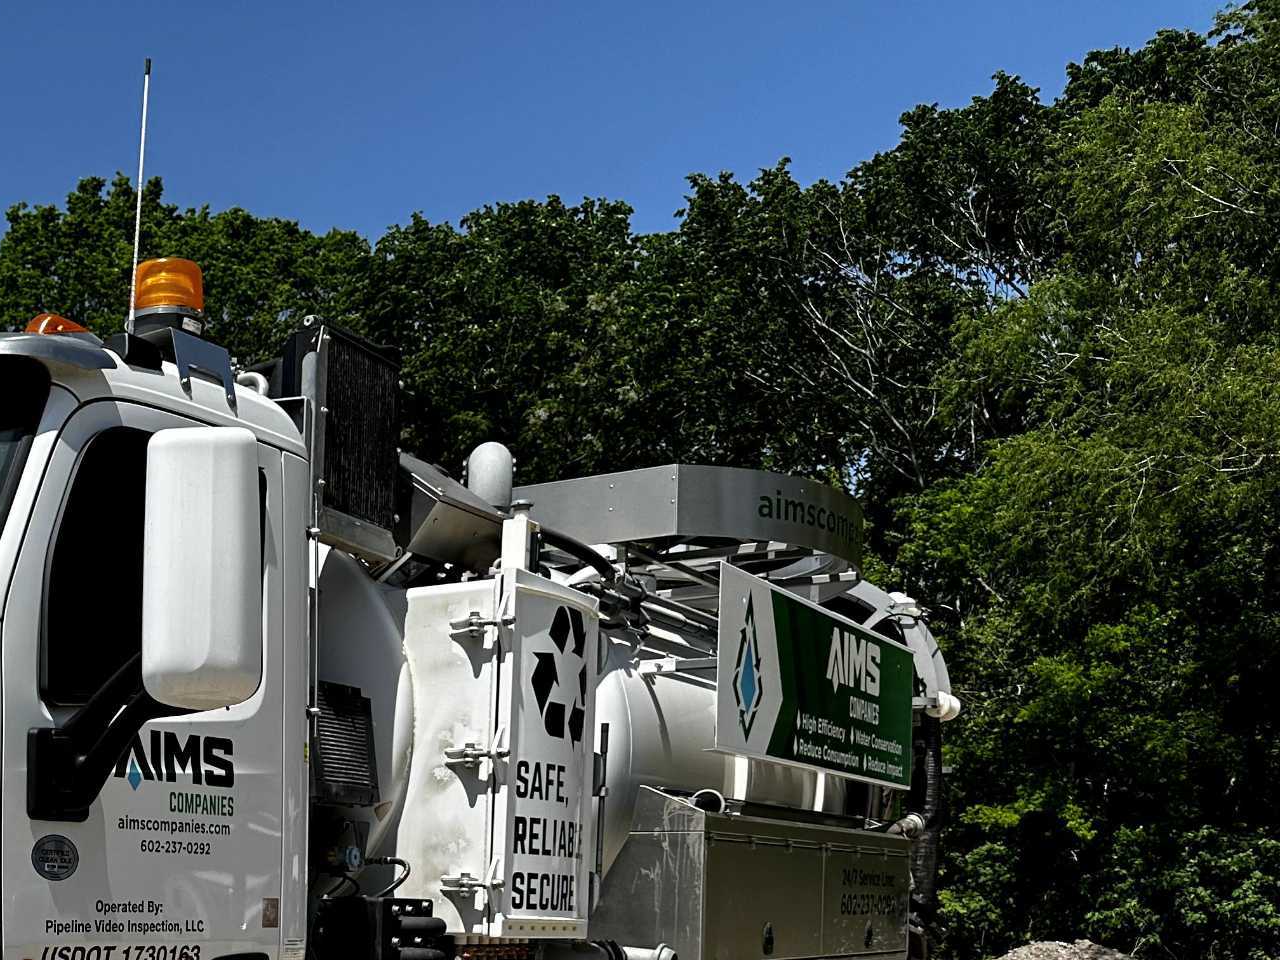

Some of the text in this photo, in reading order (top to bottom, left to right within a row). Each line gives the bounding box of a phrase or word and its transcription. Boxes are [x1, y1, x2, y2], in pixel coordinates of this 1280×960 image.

[826, 627, 880, 696] AIMS
[849, 695, 880, 726] COMPANIES
[802, 712, 846, 743] High Efficiency
[799, 739, 860, 768] Reduce Consumption
[855, 729, 903, 756] Water Conservation
[114, 728, 235, 789] AIMS
[867, 755, 903, 779] Reduce Impact
[516, 760, 569, 808] SAFE,
[169, 791, 234, 817] COMPANIES
[117, 814, 231, 836] aimscompanies.com
[140, 839, 211, 856] 602-237-0292
[511, 871, 576, 912] SECURE
[95, 900, 164, 916] Operated By:
[45, 919, 205, 936] Pipeline Video Inspection, LLC
